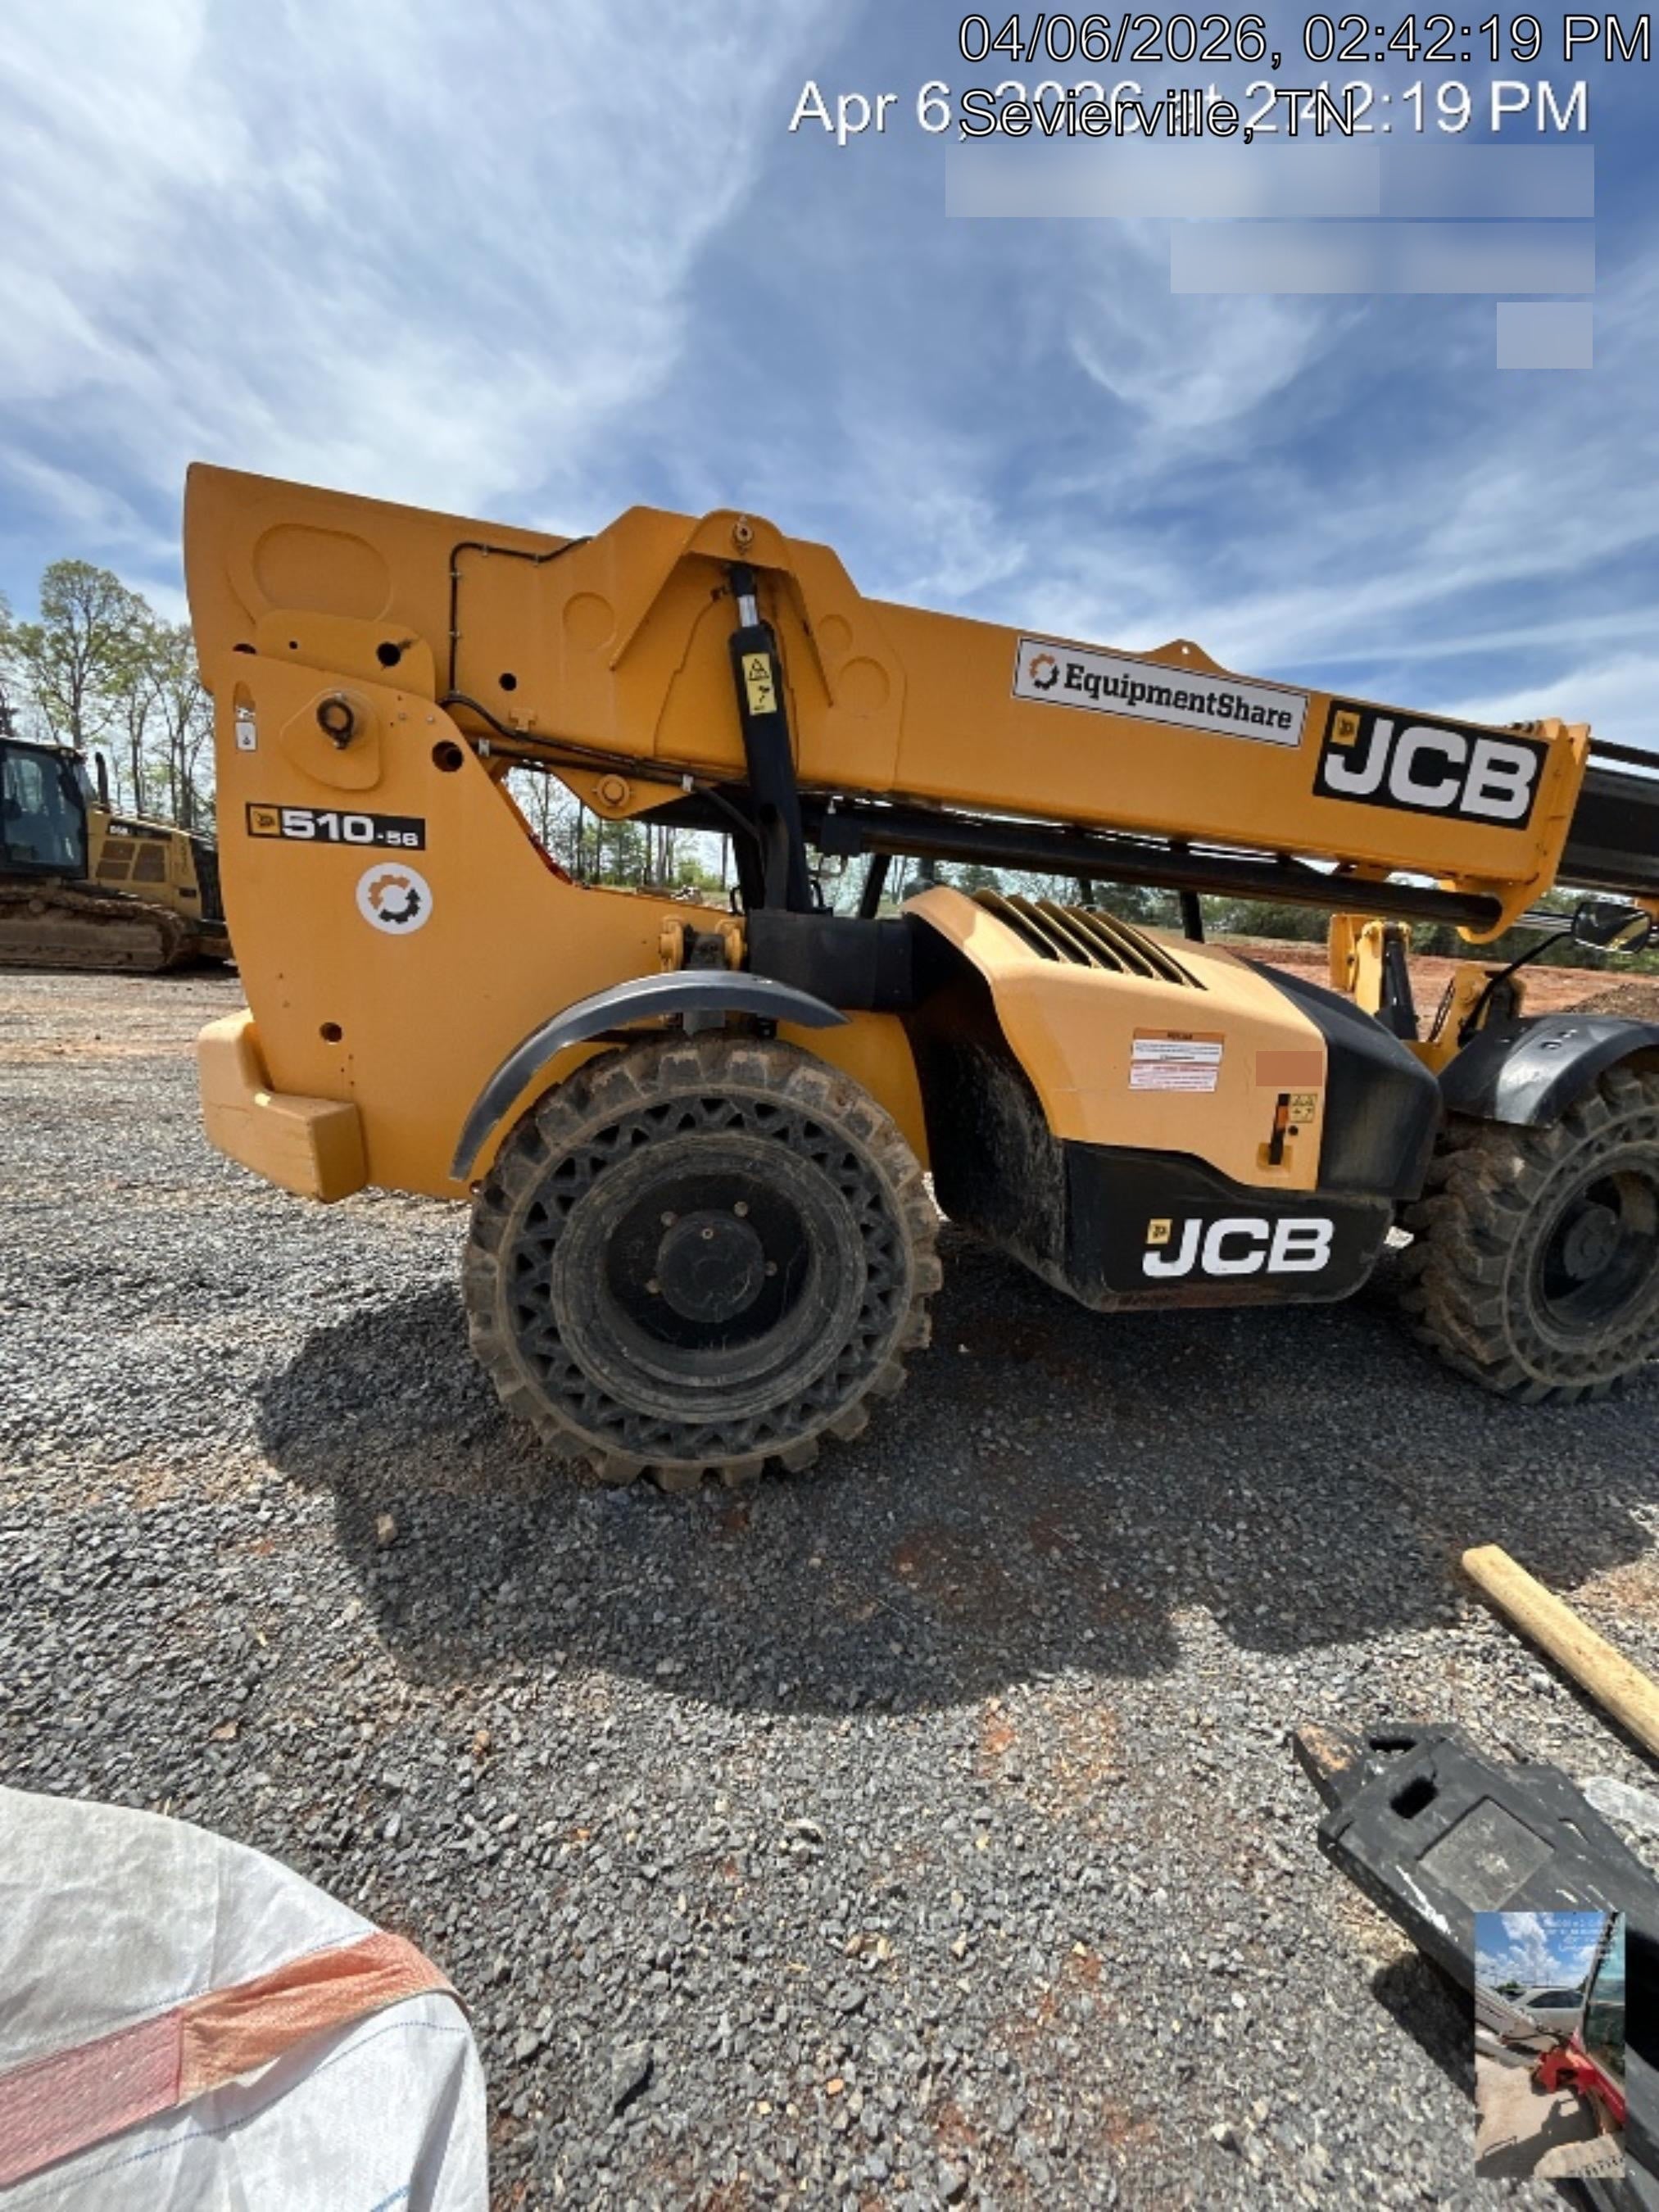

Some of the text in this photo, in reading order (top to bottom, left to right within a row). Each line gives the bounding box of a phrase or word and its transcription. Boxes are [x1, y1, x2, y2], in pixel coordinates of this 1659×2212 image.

[1064, 662, 1292, 731] EquipmentShare
[1324, 717, 1538, 820] JCB
[1142, 1217, 1335, 1277] JCB
